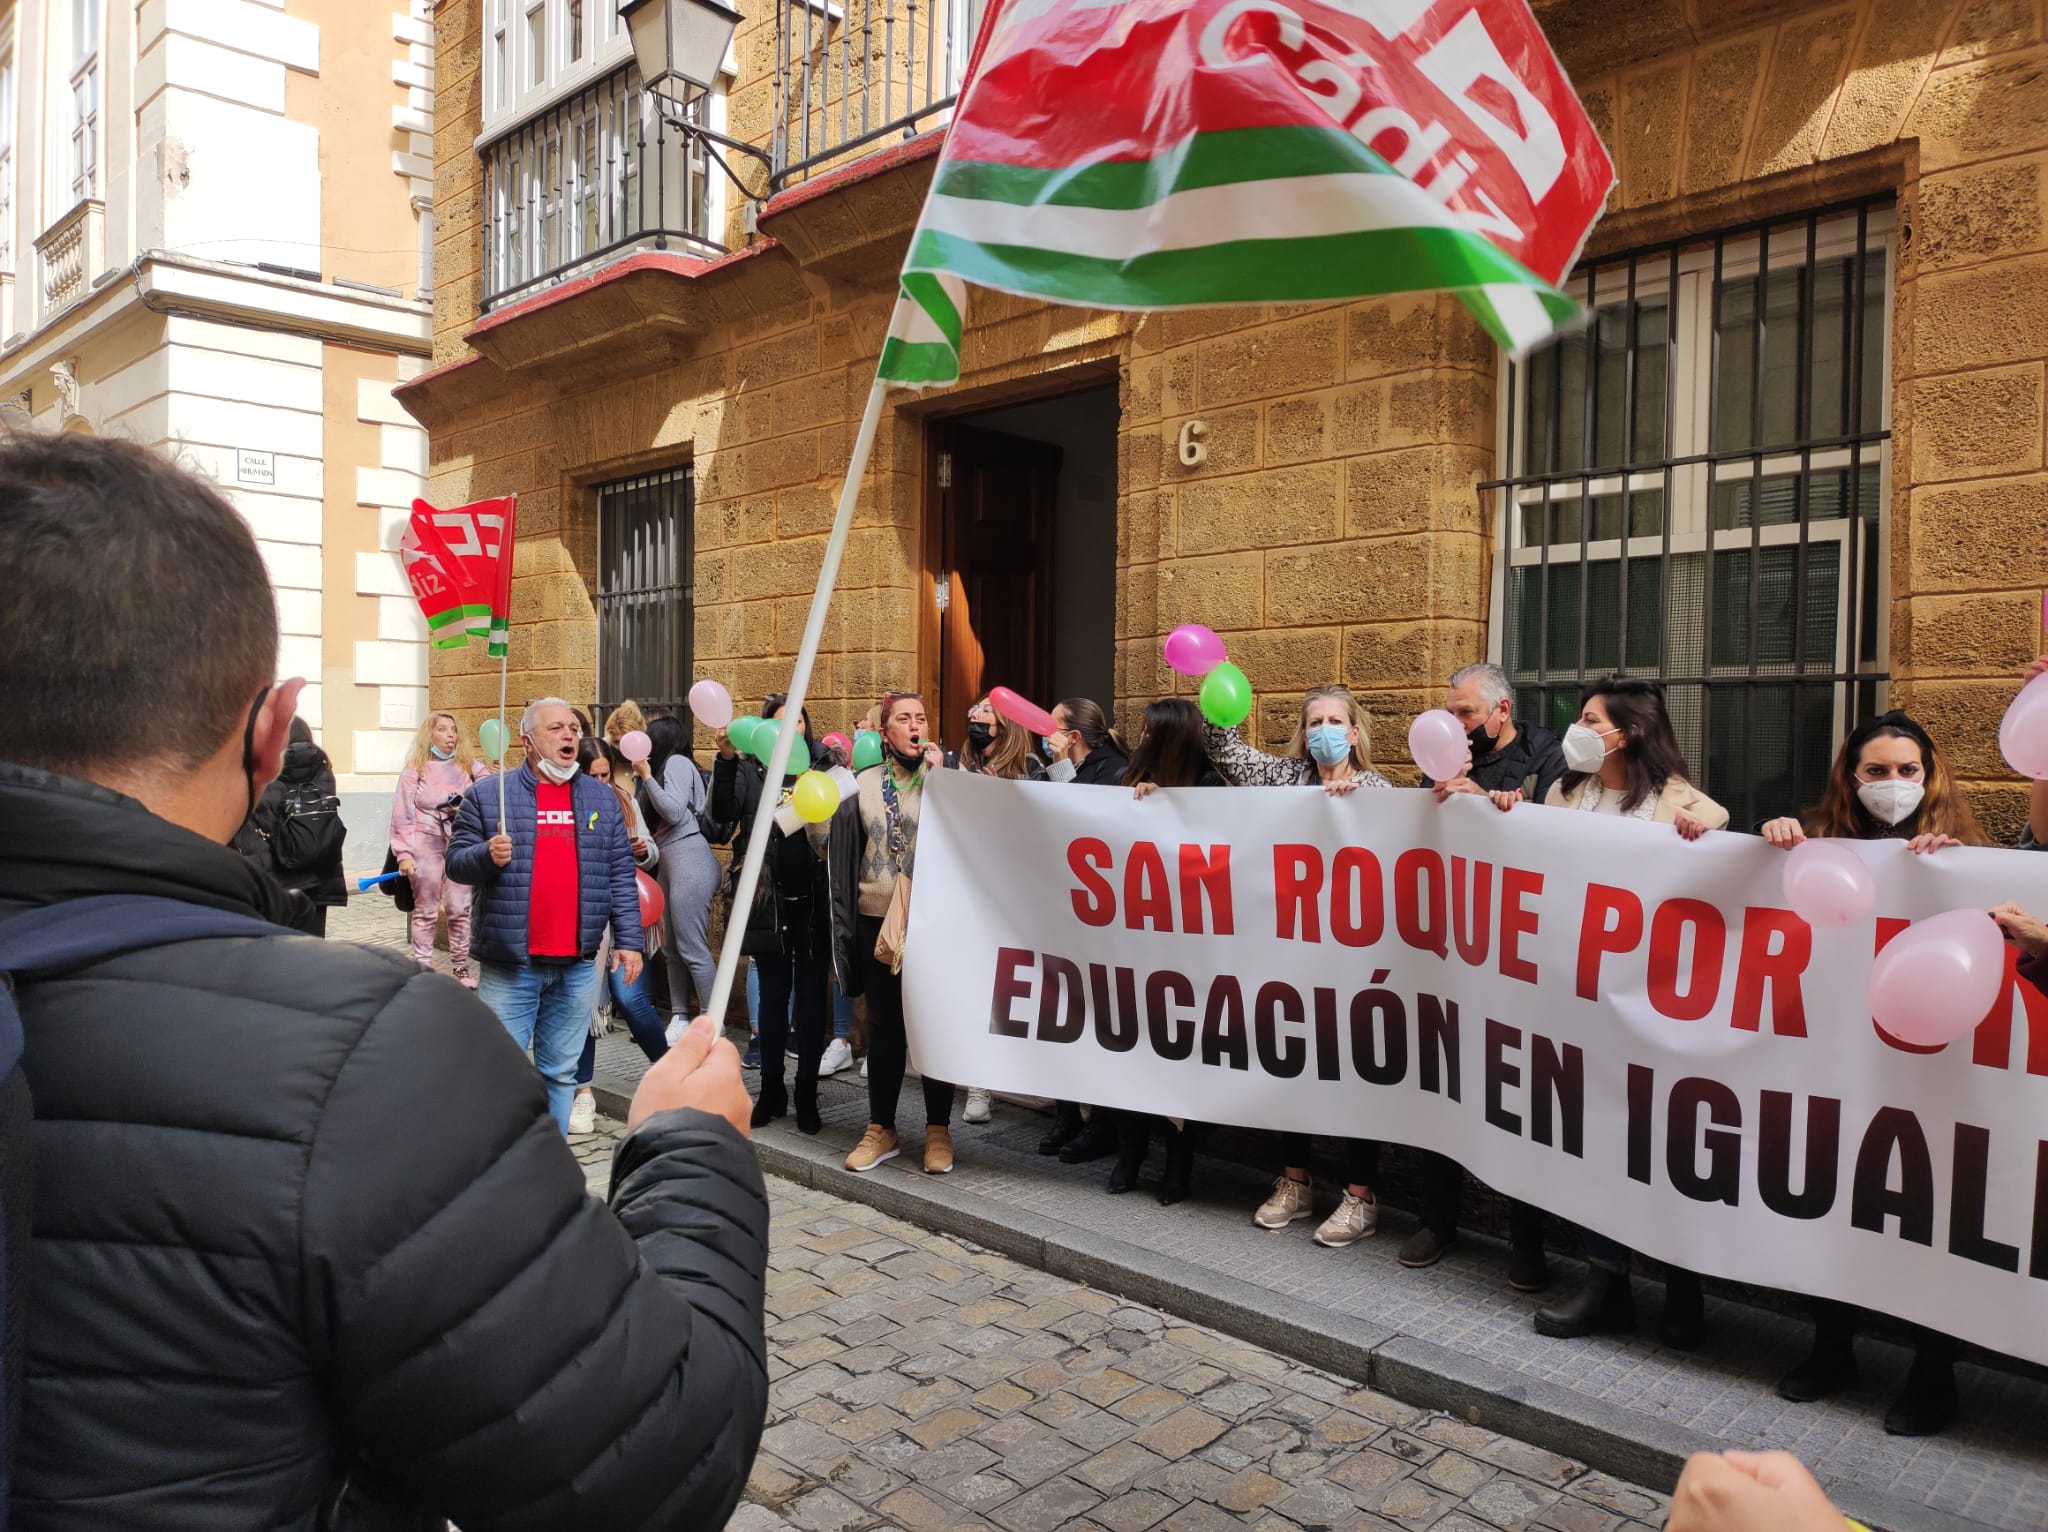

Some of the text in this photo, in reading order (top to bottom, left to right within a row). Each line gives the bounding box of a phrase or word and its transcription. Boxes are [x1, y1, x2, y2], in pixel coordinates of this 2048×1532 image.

[244, 457, 267, 466] CALLE
[1179, 420, 1207, 465] 6
[1067, 837, 1235, 936] SAN
[1273, 844, 1545, 986] ROQUE
[1576, 883, 1813, 1039] POR
[989, 946, 1461, 1104] EDUCACIÓN
[1485, 1017, 1584, 1160] EN
